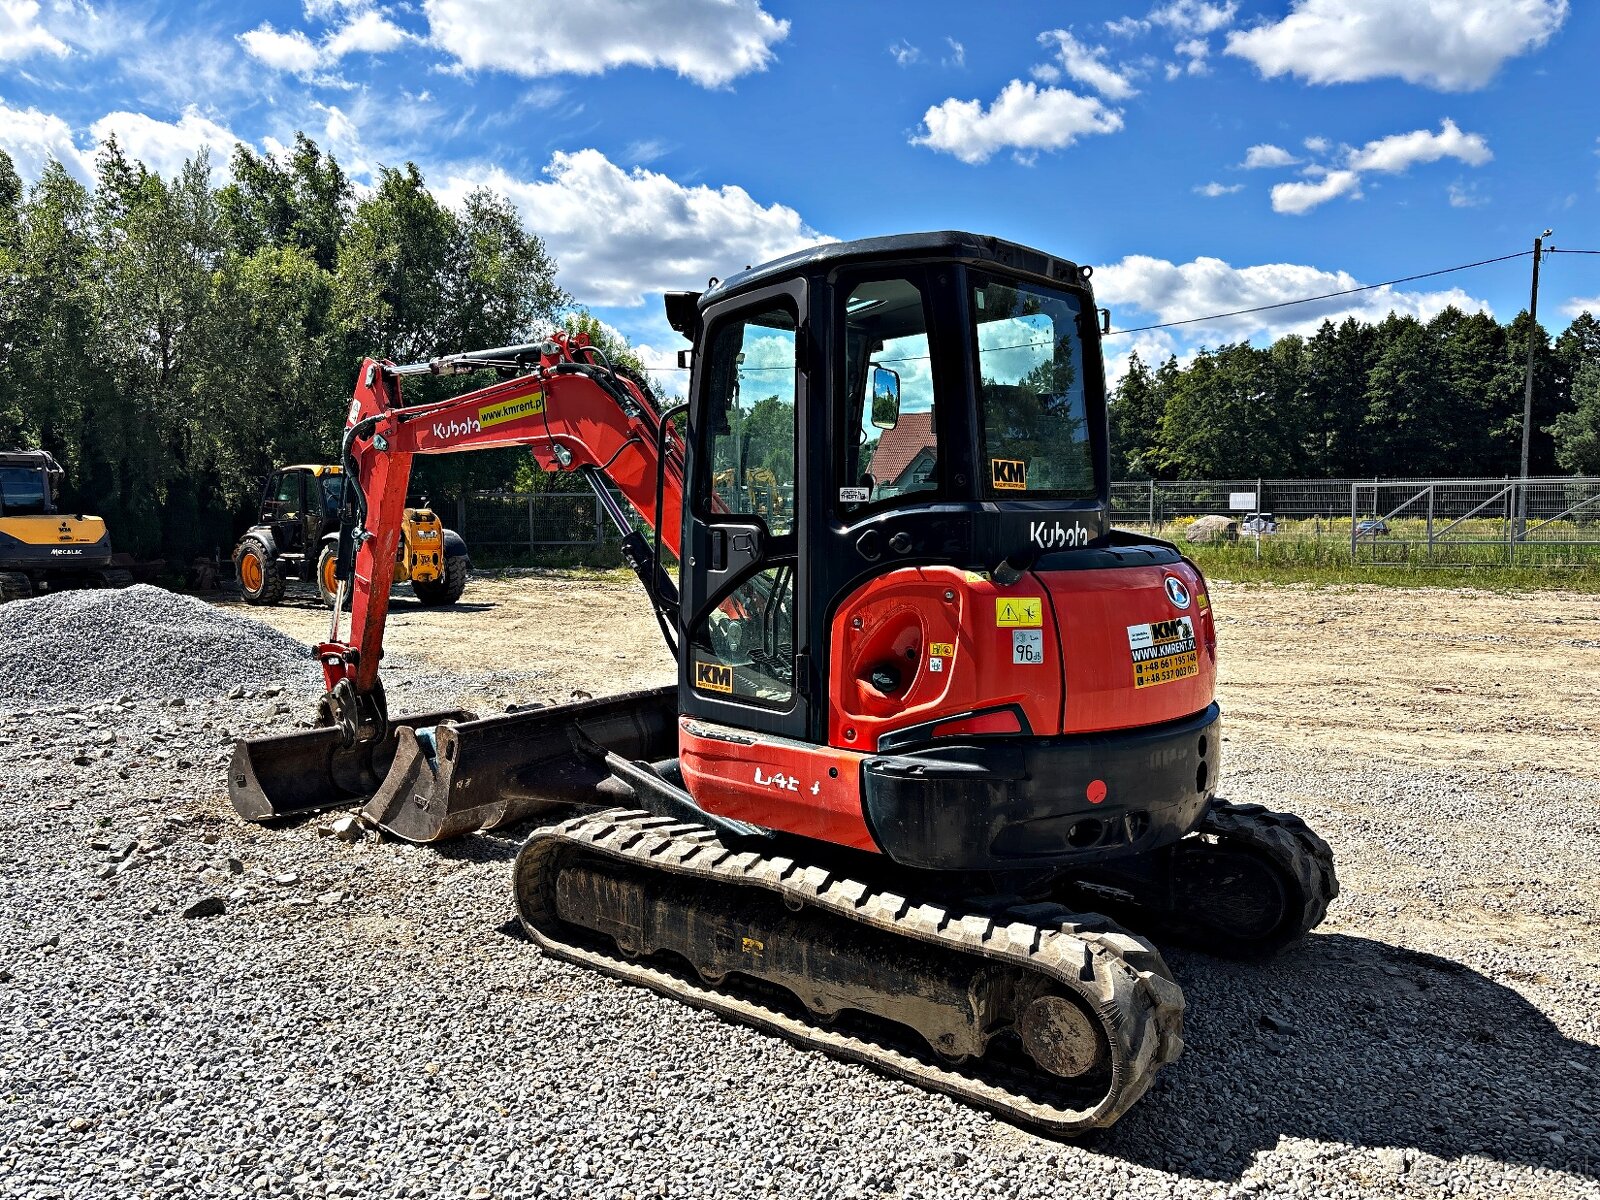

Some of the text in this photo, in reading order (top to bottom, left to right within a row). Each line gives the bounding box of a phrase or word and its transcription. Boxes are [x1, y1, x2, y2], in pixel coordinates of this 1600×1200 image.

[433, 417, 480, 439] Kubota
[993, 460, 1024, 483] KM
[1030, 520, 1088, 548] Kubota
[1151, 621, 1178, 639] KM
[1016, 644, 1033, 661] 96
[1132, 639, 1196, 661] WWW.KMRENT.PL
[1144, 660, 1159, 672] +48
[1160, 658, 1173, 669] 661
[1175, 654, 1186, 666] 195
[697, 663, 731, 687] KM
[1145, 673, 1161, 684] +48
[1162, 670, 1175, 681] 537
[1176, 666, 1187, 678] 003
